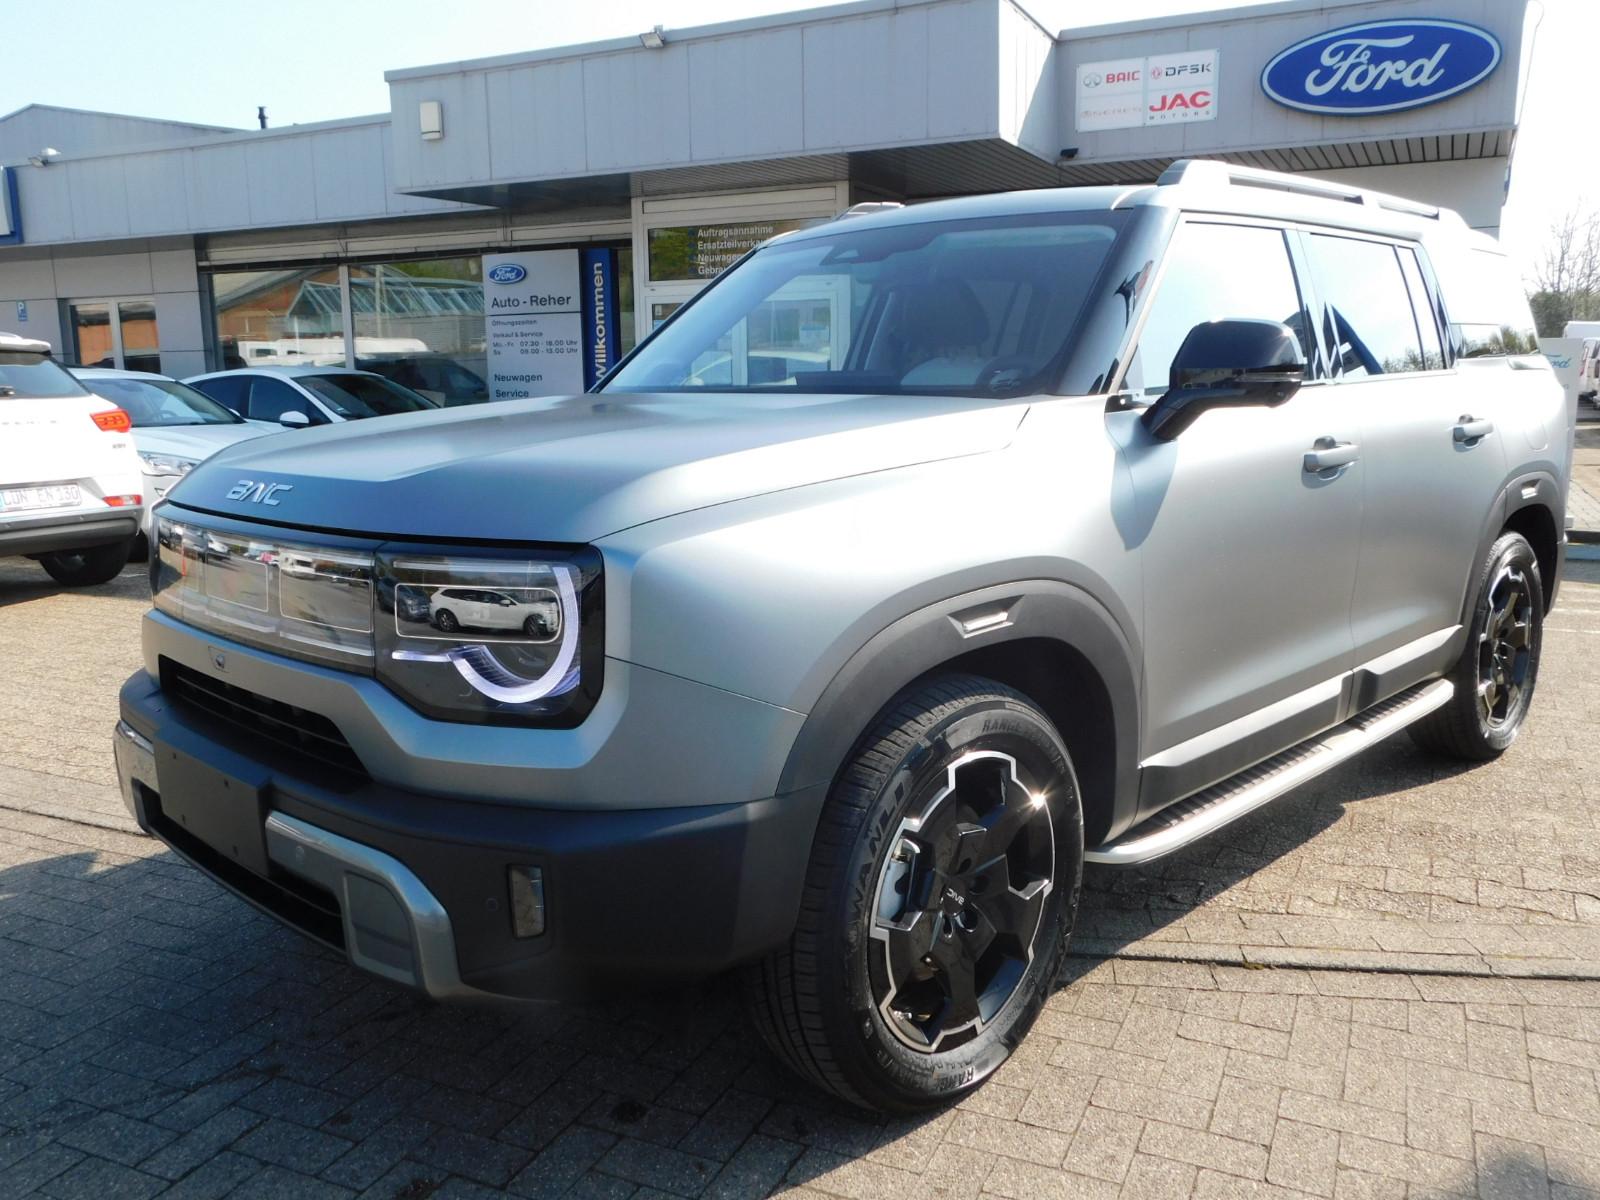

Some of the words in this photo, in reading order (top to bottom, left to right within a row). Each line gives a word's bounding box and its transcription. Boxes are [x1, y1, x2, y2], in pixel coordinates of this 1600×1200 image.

[1165, 63, 1212, 77] DFSK
[1304, 34, 1451, 96] Ford
[1105, 70, 1141, 84] BAIC
[1149, 91, 1211, 112] JAC
[1149, 111, 1210, 120] MOTORS
[697, 225, 774, 238] Auftragsannahme
[494, 267, 518, 281] Ford
[491, 297, 520, 309] Auto
[530, 295, 572, 307] Reher
[494, 373, 543, 383] Neuwagen
[495, 389, 530, 399] Service
